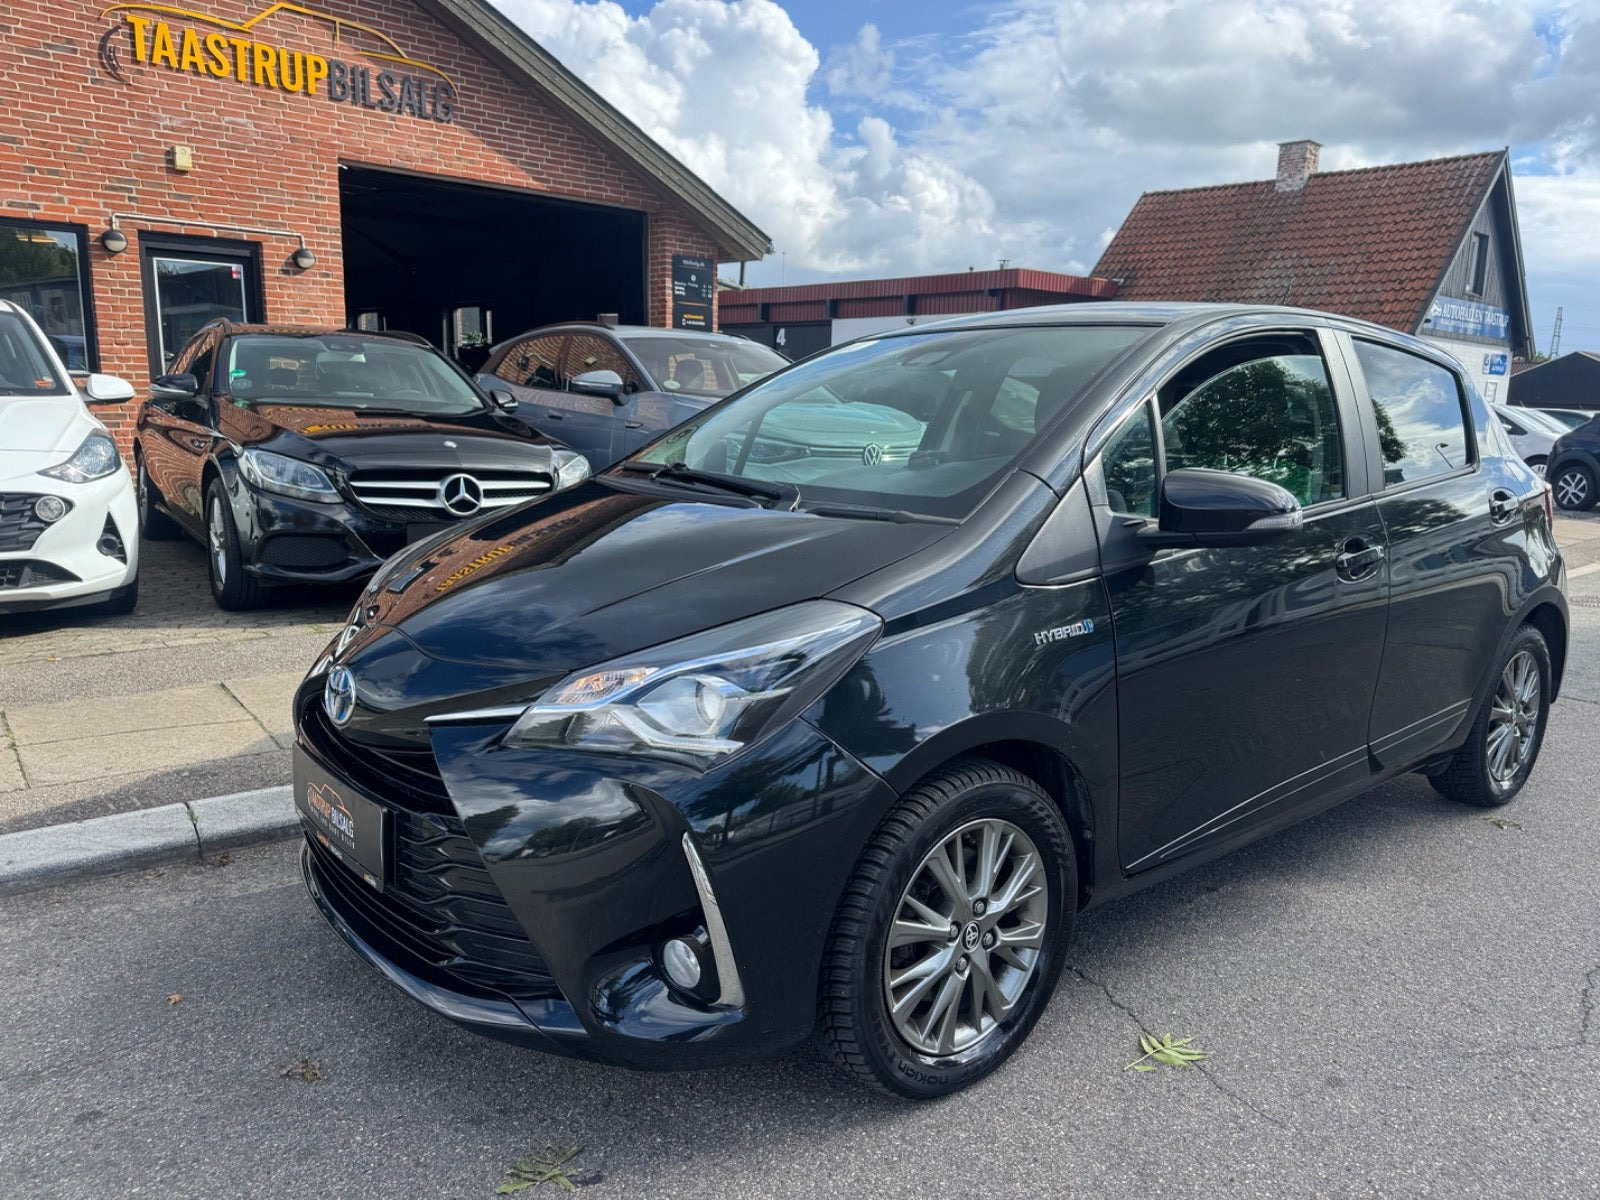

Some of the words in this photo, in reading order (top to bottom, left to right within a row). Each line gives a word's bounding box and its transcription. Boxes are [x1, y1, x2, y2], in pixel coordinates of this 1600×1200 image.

[1441, 303, 1483, 324] AUTOHALLEN
[776, 328, 786, 346] 4
[1034, 622, 1084, 645] HYBRID
